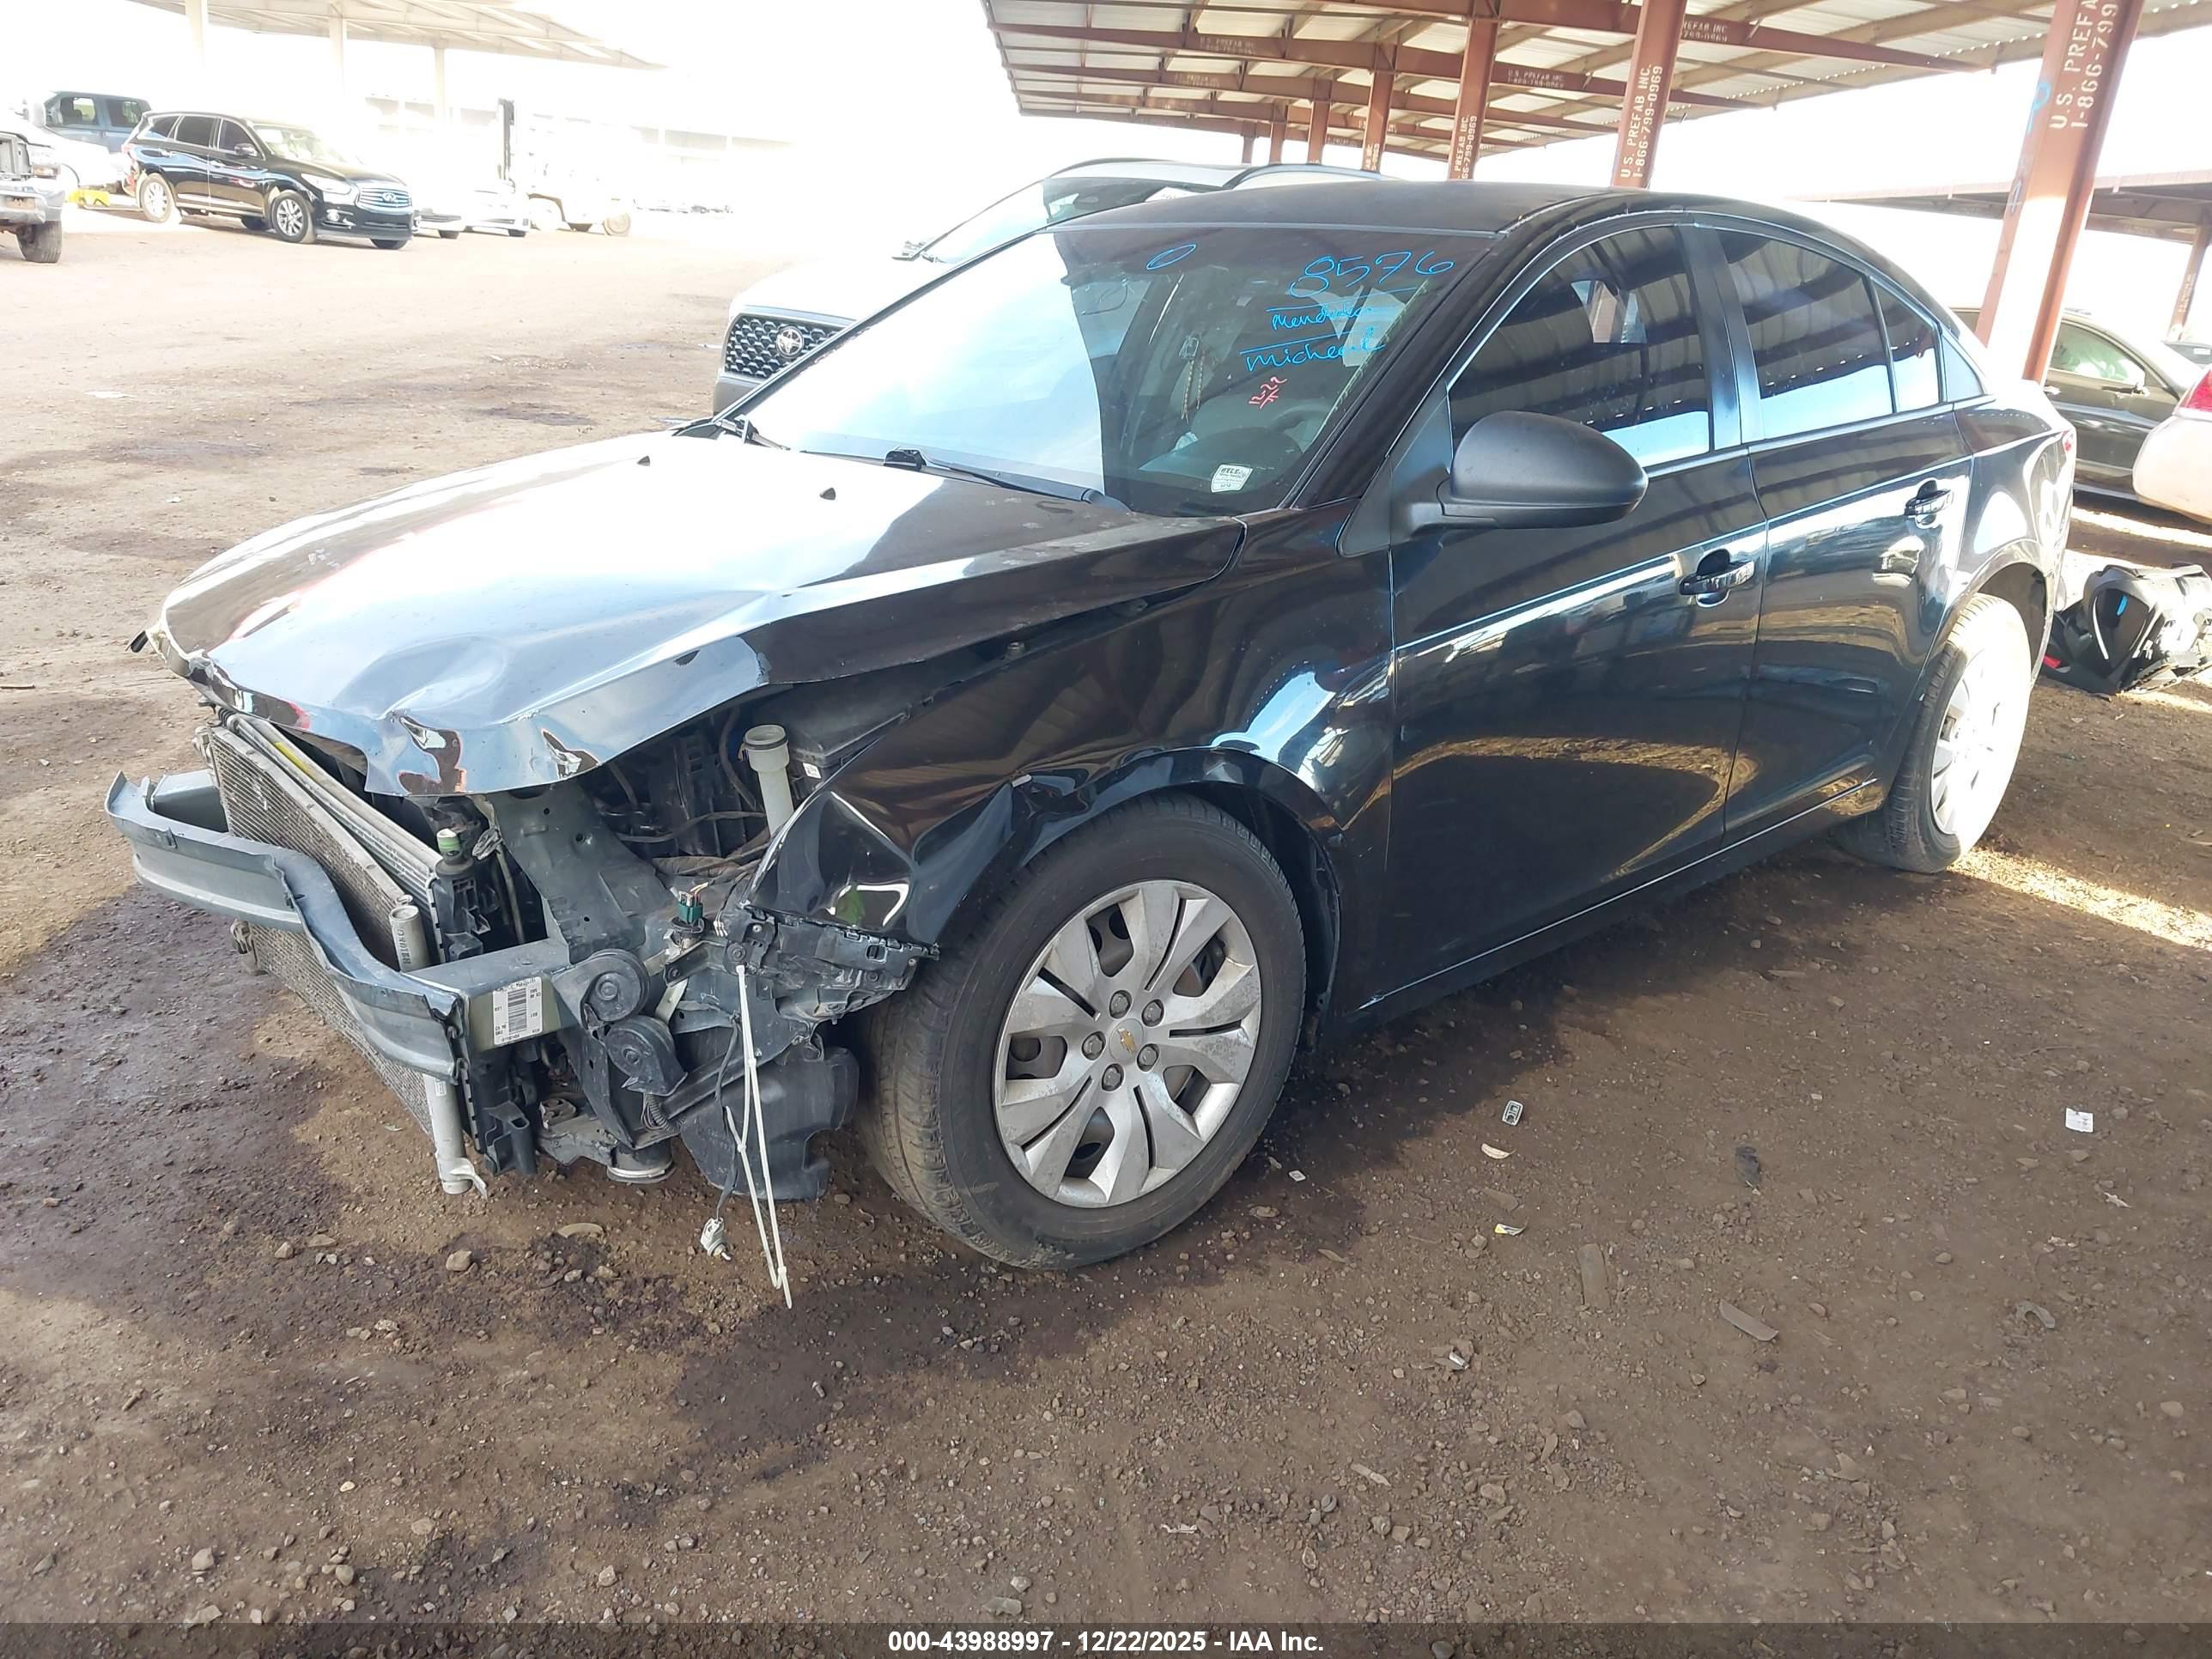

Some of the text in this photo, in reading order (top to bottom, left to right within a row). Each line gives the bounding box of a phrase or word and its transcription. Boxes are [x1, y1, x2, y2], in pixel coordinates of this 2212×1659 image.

[1683, 21, 1710, 32] REFAB
[2050, 0, 2099, 129] U.S. PREFA
[2070, 2, 2118, 129] 1-866-799
[1627, 95, 1644, 146] PREFAB
[1638, 64, 1652, 89] INC.
[1632, 65, 1663, 178] 1-866-799-0969
[1455, 137, 1466, 171] PREFAB
[1462, 115, 1477, 179] 66-799-0969
[1290, 250, 1455, 299] 8576
